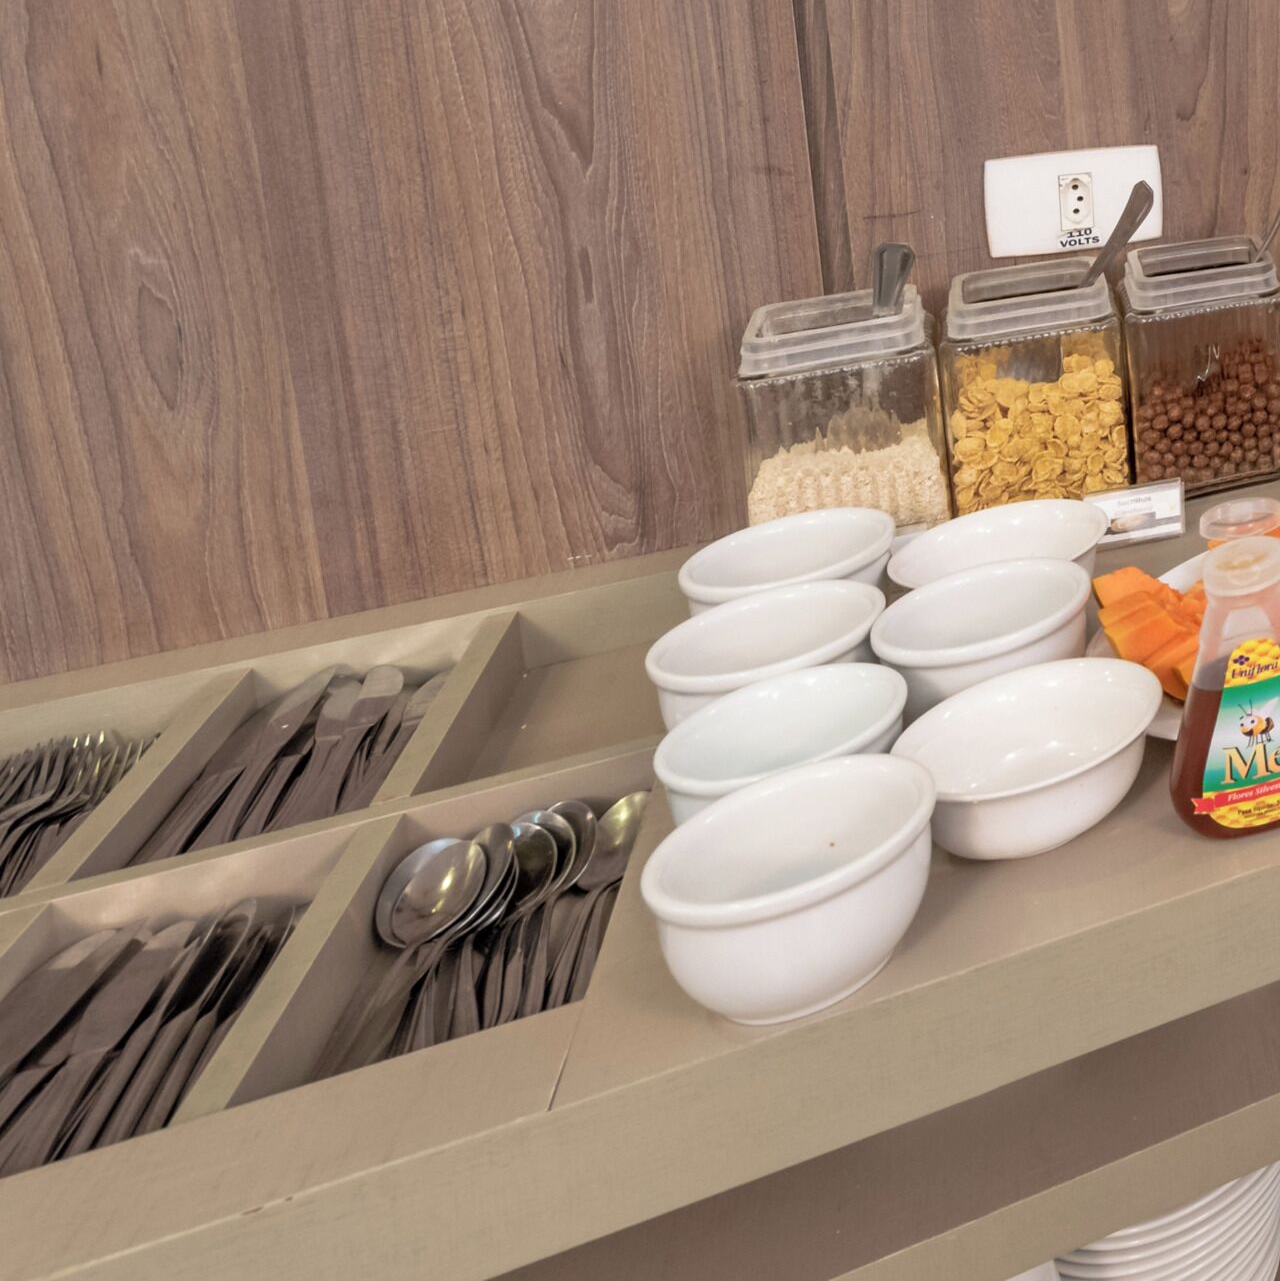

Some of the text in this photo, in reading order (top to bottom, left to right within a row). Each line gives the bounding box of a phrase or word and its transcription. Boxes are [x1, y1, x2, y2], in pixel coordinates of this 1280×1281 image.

[1066, 227, 1092, 238] 110
[1060, 235, 1100, 248] VOLTS
[1227, 790, 1254, 802] Flores
